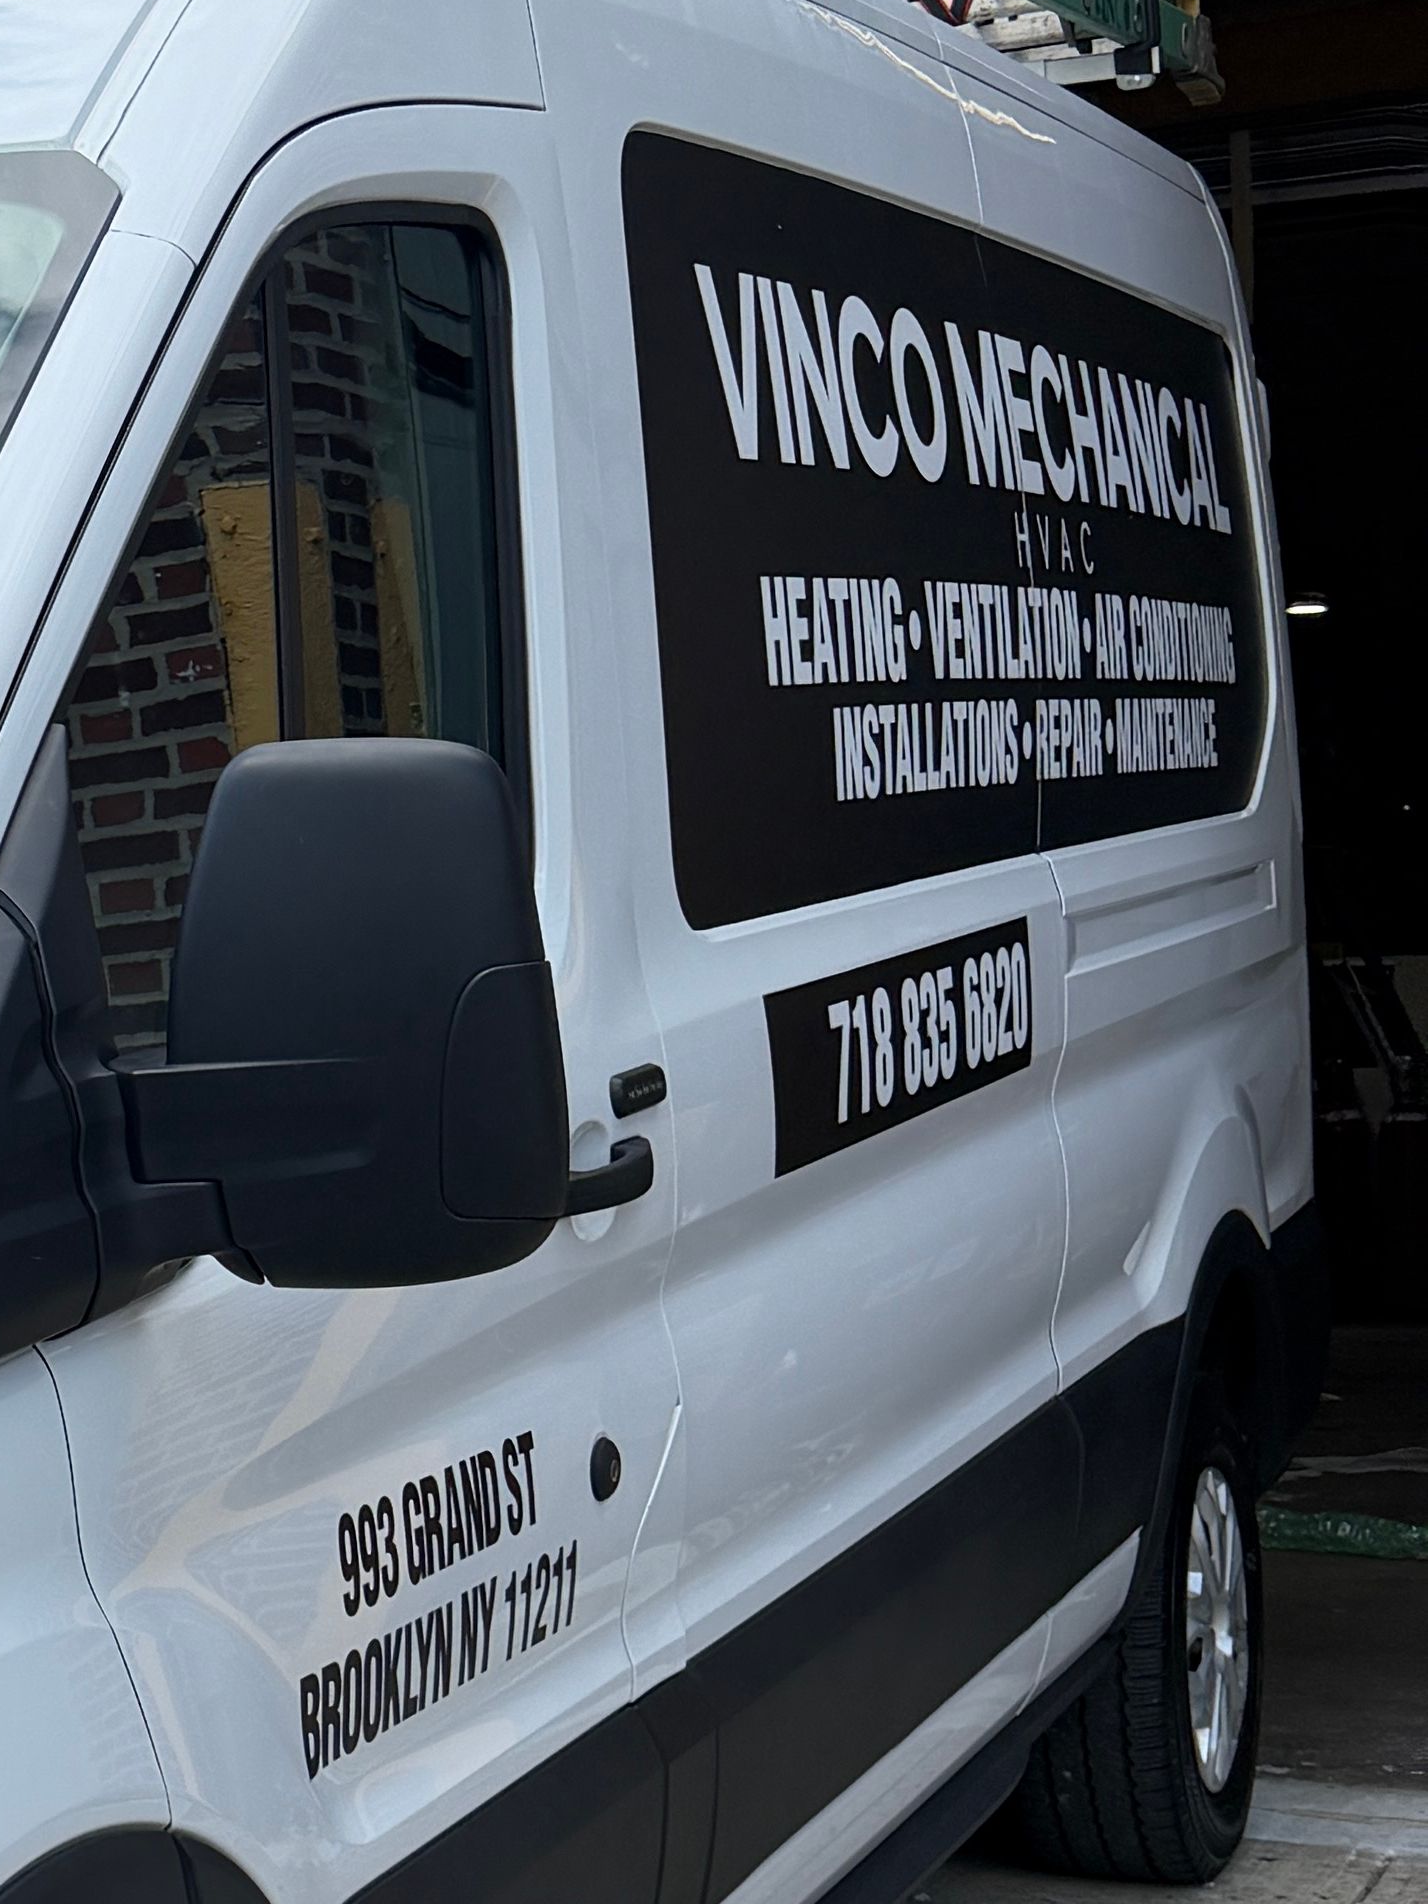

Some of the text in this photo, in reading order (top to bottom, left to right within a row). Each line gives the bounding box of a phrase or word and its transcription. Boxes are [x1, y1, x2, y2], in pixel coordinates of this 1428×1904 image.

[693, 262, 1232, 534] VINCO MECHANICAL
[760, 576, 1236, 687] HEATING VENTILATION AIR CONDITIONING
[1015, 510, 1095, 575] HVAC
[833, 698, 1218, 802] INSTALLATIONS REPAIR MAINTENANCE
[827, 941, 1028, 1125] 718 835 6820
[338, 1430, 537, 1617] 993 GRAND ST
[300, 1539, 578, 1781] BROOKLYN NY 11211
